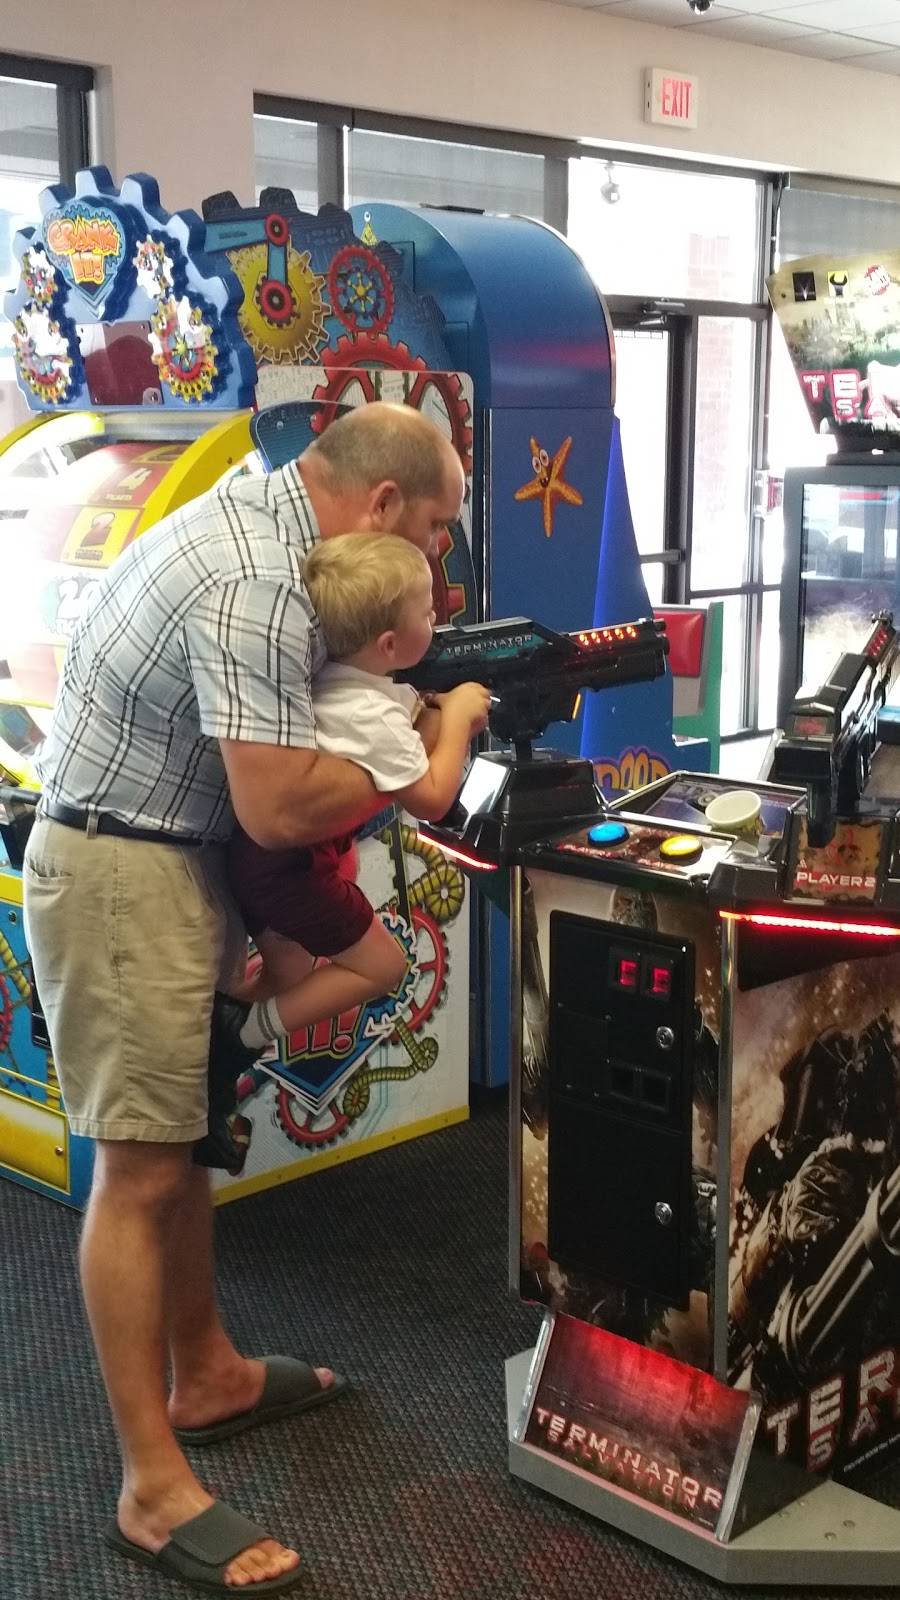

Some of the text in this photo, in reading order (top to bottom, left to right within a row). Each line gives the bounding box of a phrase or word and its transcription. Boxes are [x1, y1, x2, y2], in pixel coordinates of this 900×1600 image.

[661, 78, 692, 119] EXIT
[48, 216, 119, 254] CRANK
[71, 251, 104, 283] IT!
[80, 512, 116, 548] 2
[446, 633, 533, 656] TERMINATOR
[766, 1350, 900, 1455] TER
[536, 1407, 723, 1510] TERMINATOR
[548, 1430, 698, 1510] SALVATION
